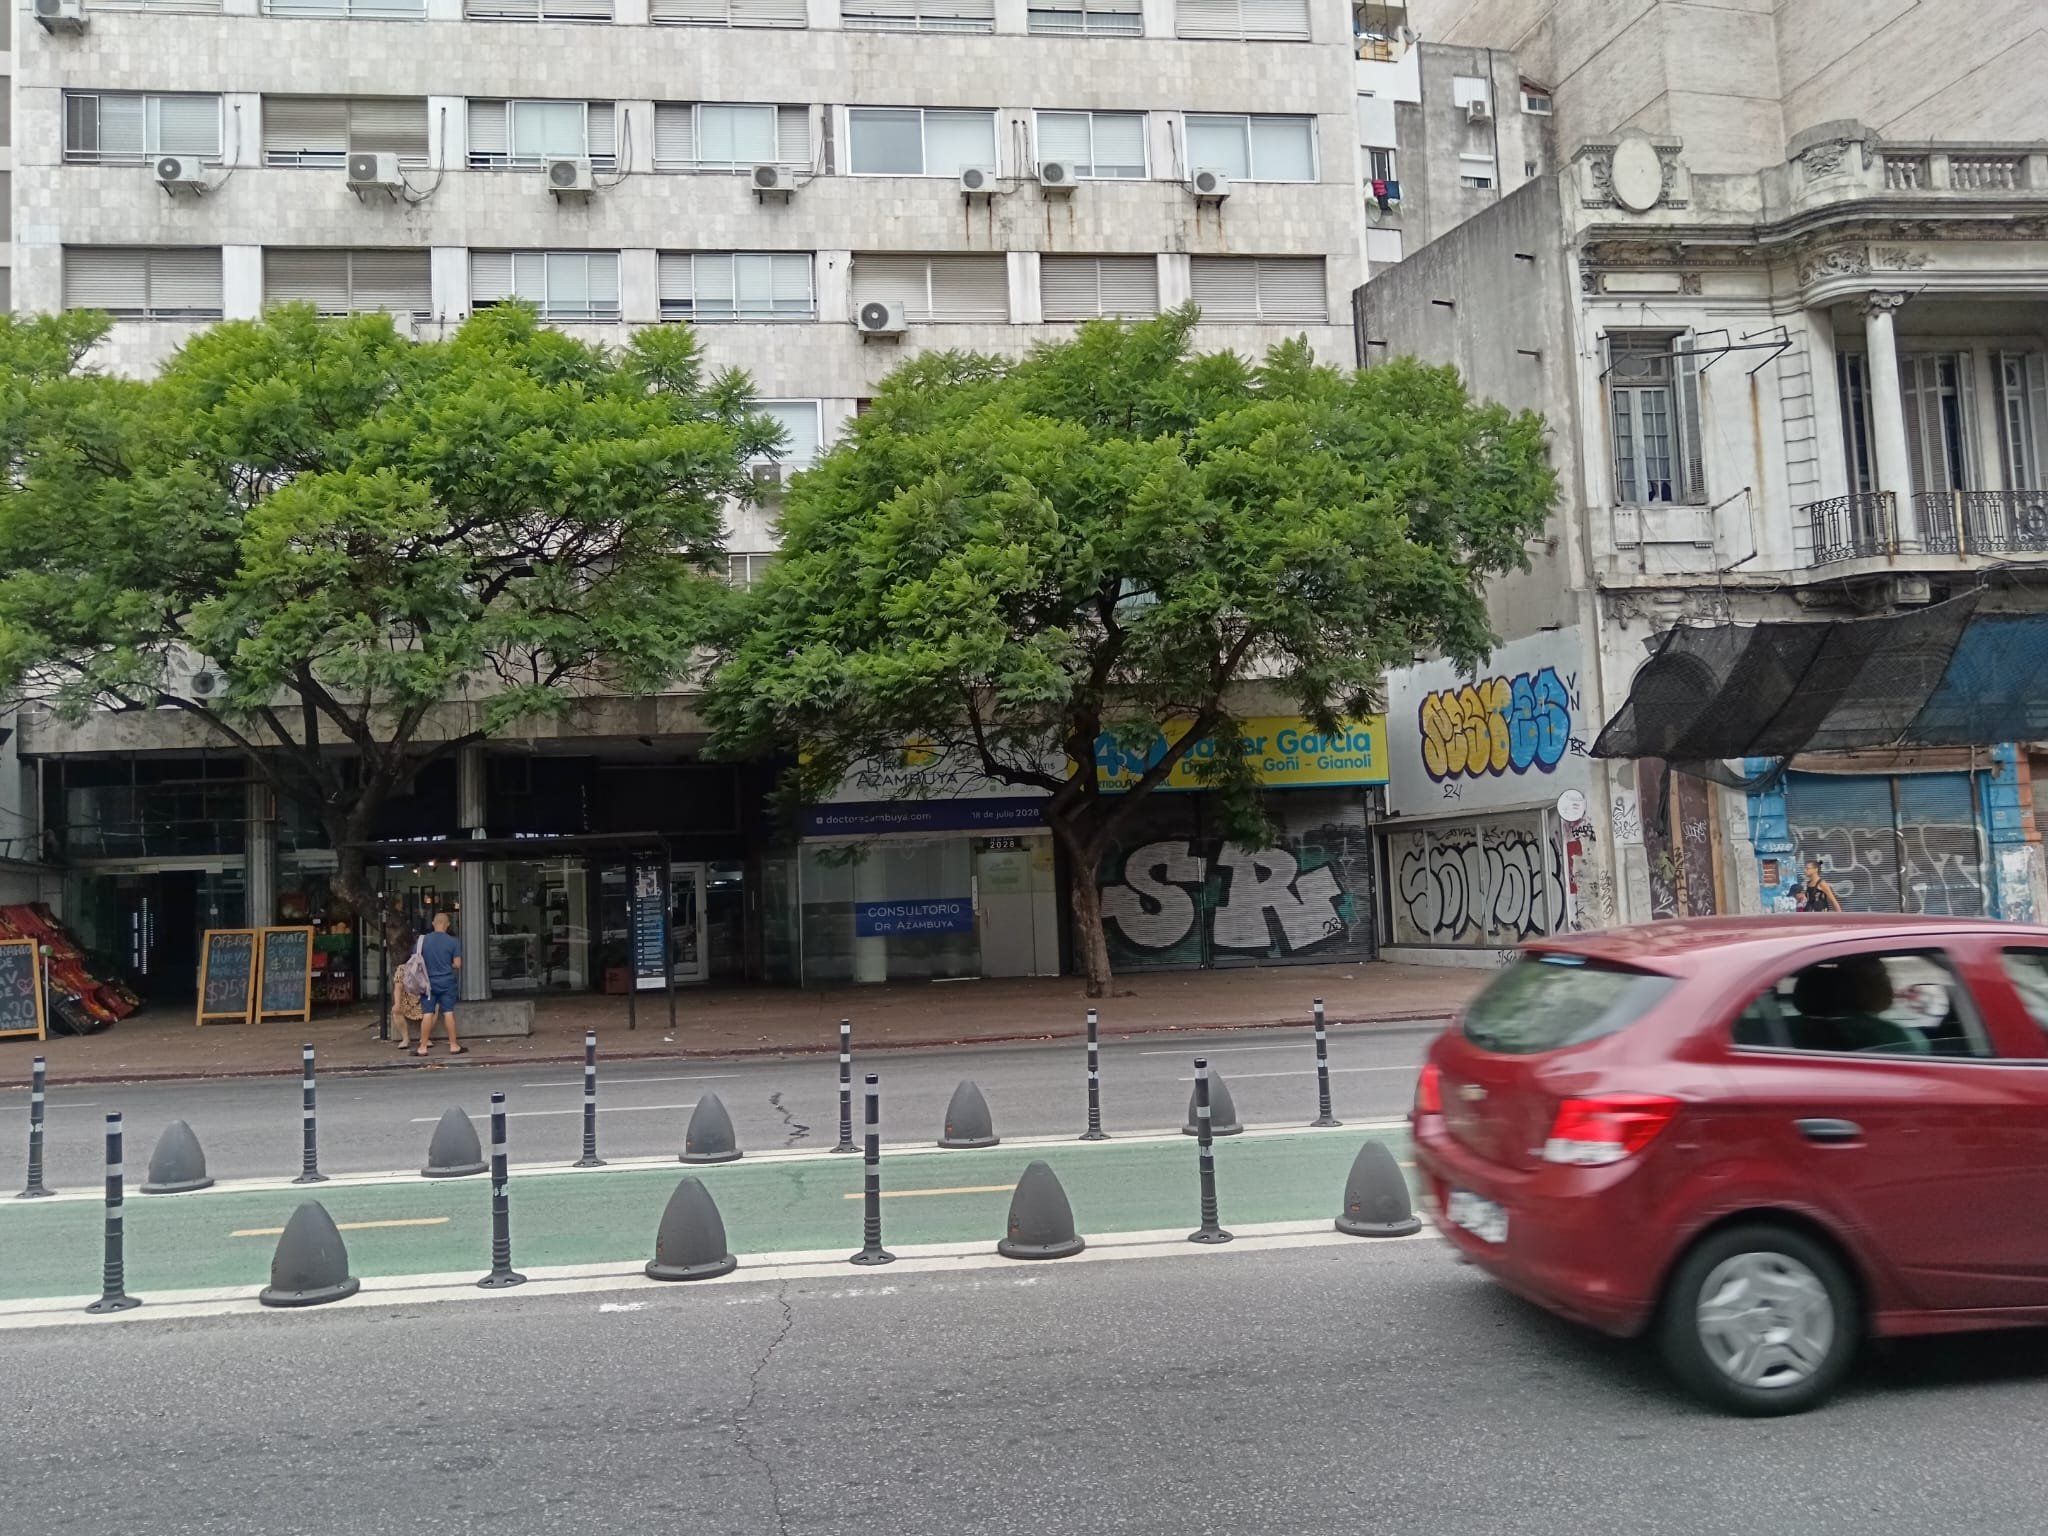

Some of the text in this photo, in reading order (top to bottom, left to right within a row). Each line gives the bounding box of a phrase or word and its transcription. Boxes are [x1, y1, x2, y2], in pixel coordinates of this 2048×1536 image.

[1183, 725, 1371, 758] aer García
[1263, 757, 1299, 771] Goñi
[1317, 754, 1371, 770] Gianoli
[856, 771, 957, 787] AZAMBUYA
[1443, 784, 1462, 800] 24
[984, 809, 994, 818] de
[996, 809, 1014, 820] julio
[1015, 808, 1040, 817] 2028
[990, 841, 1015, 849] 2028
[868, 904, 960, 917] CONSULTORIO
[212, 935, 252, 948] OFERTA
[266, 932, 307, 945] TOMATE
[8, 1000, 36, 1019] 20
